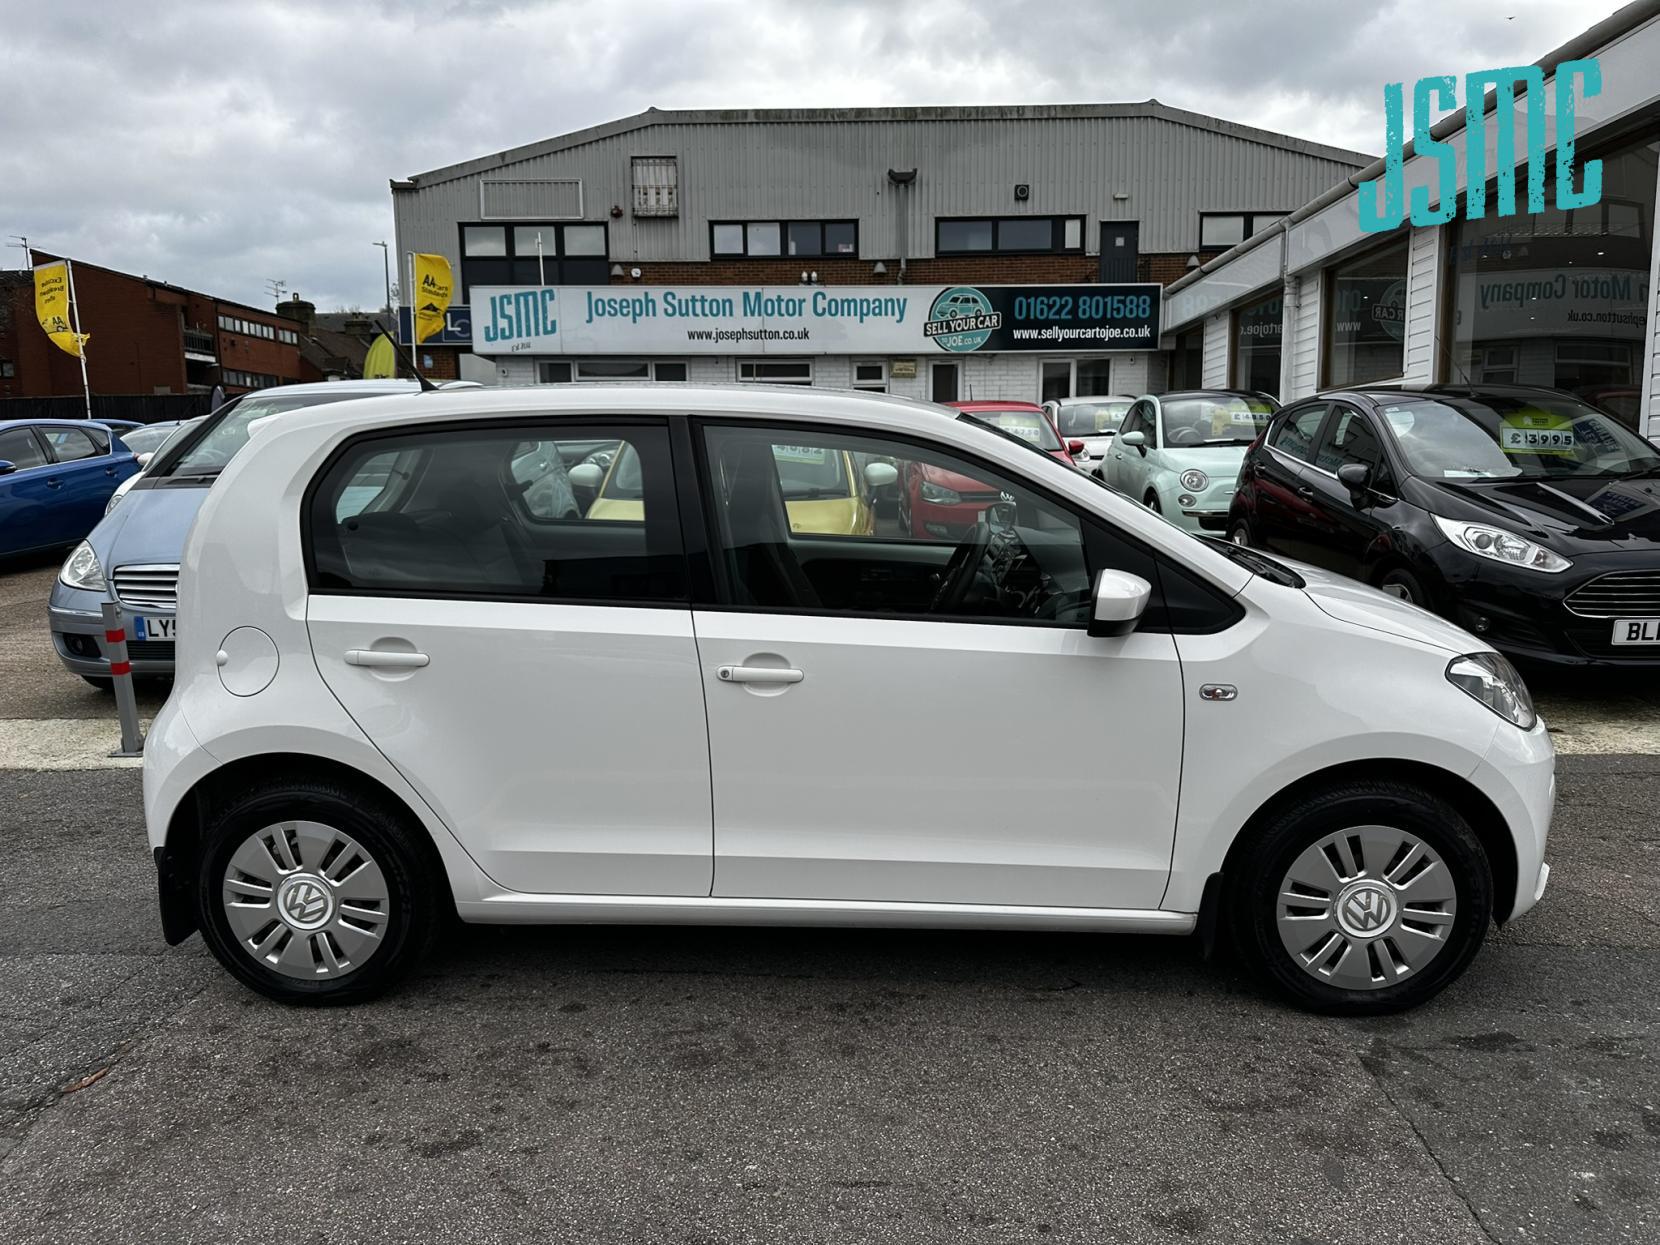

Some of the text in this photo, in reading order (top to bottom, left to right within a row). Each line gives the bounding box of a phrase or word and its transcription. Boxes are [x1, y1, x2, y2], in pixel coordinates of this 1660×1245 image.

[484, 289, 557, 342] JSMC
[586, 291, 907, 324] Joseph Sutton Motor Company
[1014, 295, 1151, 320] 01622 801588
[687, 327, 810, 343] www.josephsutton.co.uk
[926, 314, 998, 335] SELL YOUR CAR
[1013, 324, 1151, 342] www.sellyourcartojoe.co.uk
